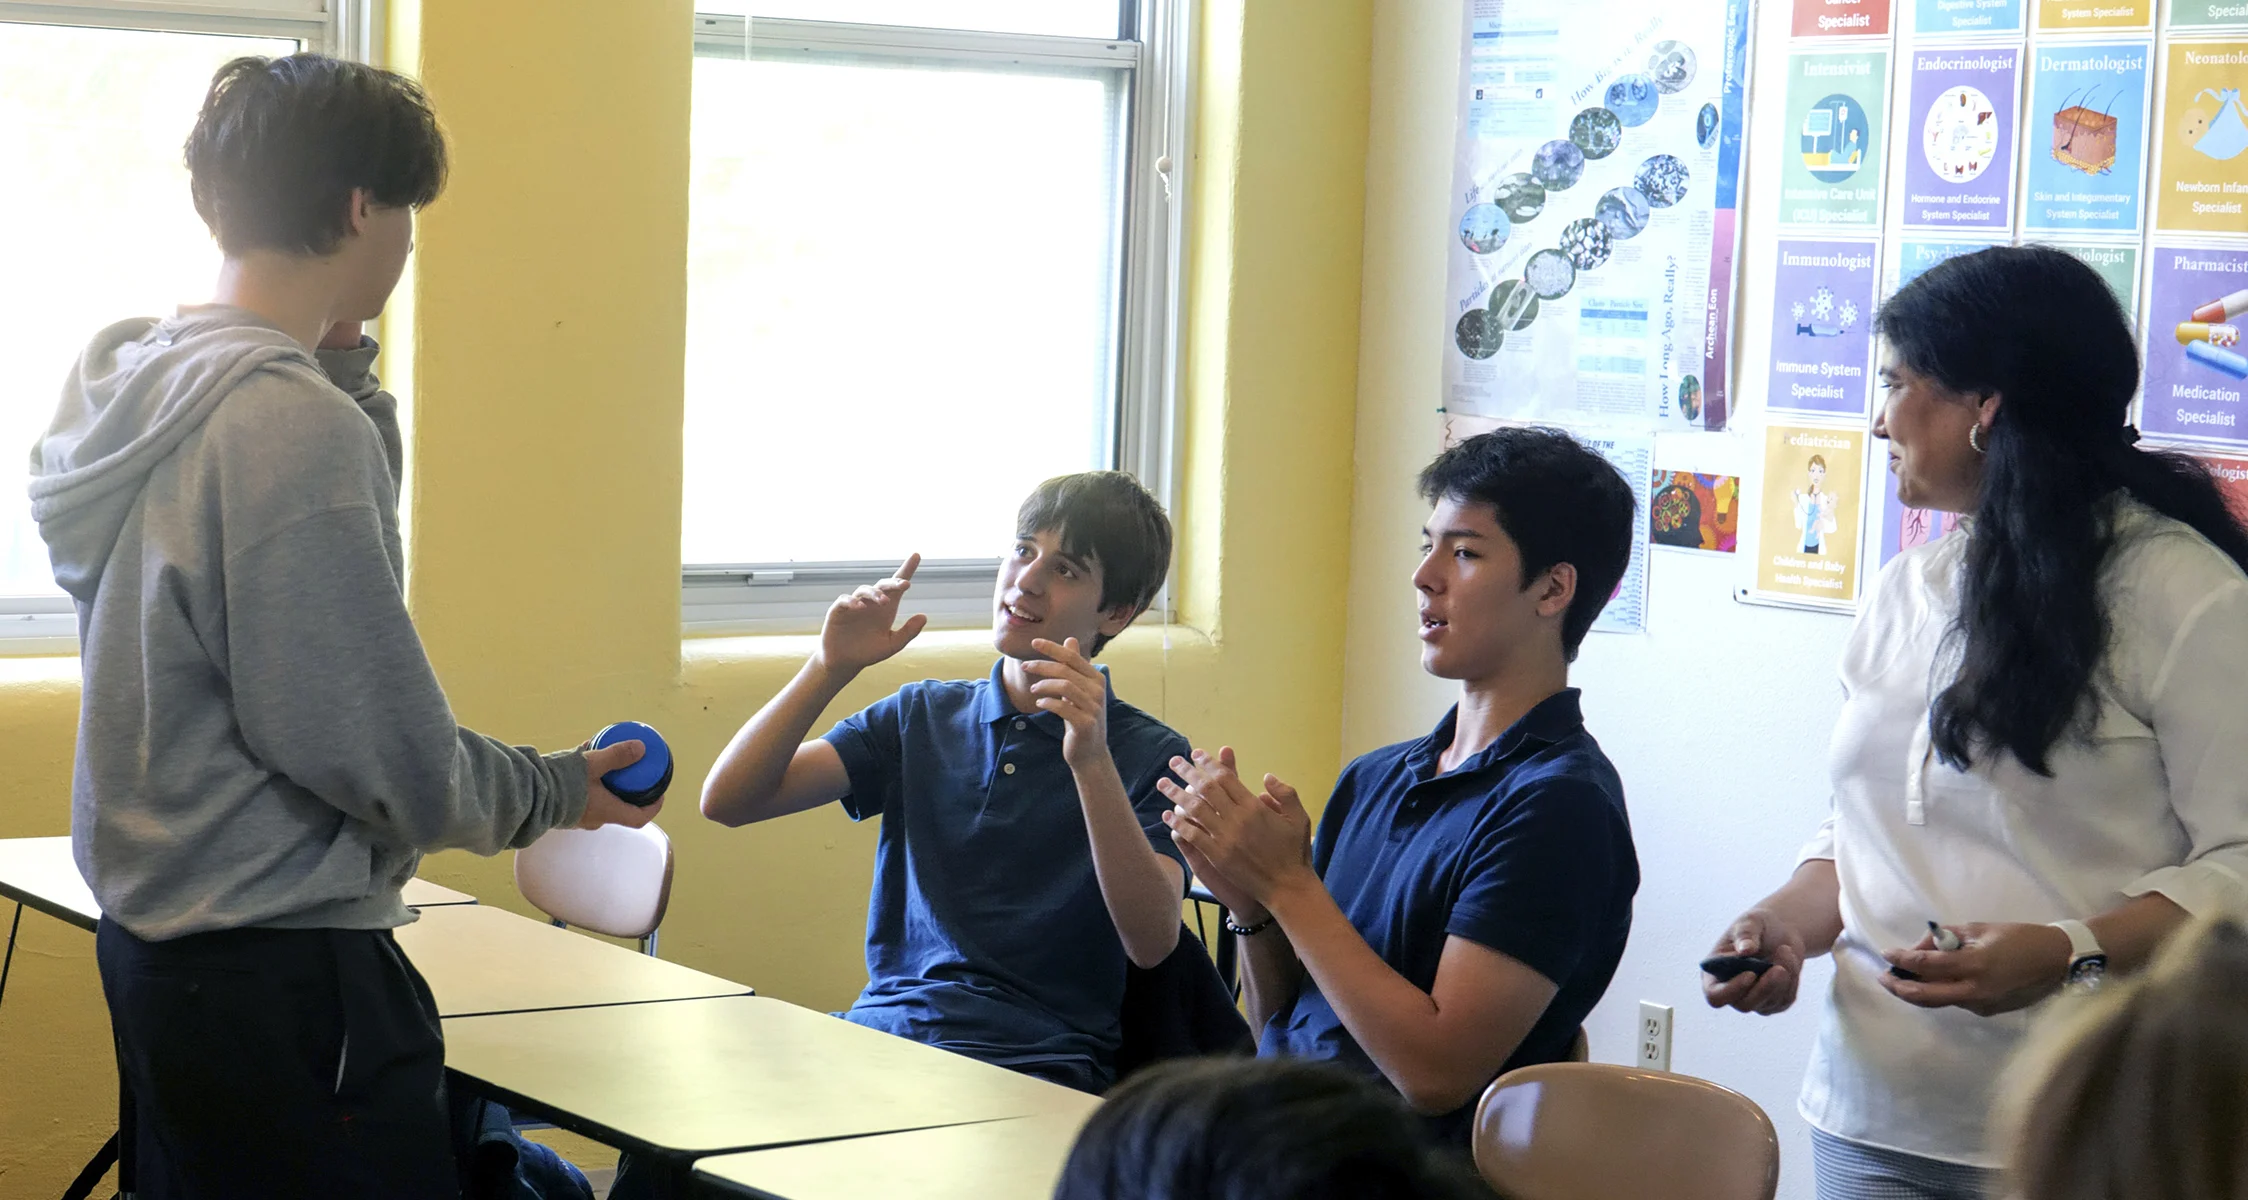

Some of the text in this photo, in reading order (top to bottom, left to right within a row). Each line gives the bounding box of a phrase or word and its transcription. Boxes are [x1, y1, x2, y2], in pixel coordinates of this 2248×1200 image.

[1937, 0, 2008, 12] Digestive System
[2062, 6, 2134, 19] System Specialist
[1727, 4, 1737, 26] Eon
[1818, 13, 1871, 30] Specialist
[1952, 15, 1992, 28] Specialist
[1804, 59, 1872, 77] Intensivist
[1917, 55, 2013, 73] Endocrinologist
[2040, 55, 2143, 75] Dermatologist
[1570, 83, 1595, 106] How
[1464, 183, 1480, 204] Life
[1830, 187, 1854, 201] Care
[1855, 188, 1876, 201] Unit
[2176, 181, 2220, 193] Newborn
[1911, 193, 2001, 205] Hormone and Endocrine
[2034, 191, 2131, 205] Skin and Integumentary
[1819, 208, 1868, 224] Specialist
[1922, 209, 1990, 222] System Specialist
[2046, 209, 2119, 221] System Specialist
[2192, 201, 2243, 215] Specialist
[1783, 251, 1871, 272] Immunologist
[2173, 255, 2248, 273] Pharmacist
[1663, 255, 1679, 304] Really?
[1705, 288, 1718, 360] Archean Eon
[1776, 360, 1862, 379] Immune System
[1791, 384, 1844, 400] Specialist
[2172, 384, 2240, 402] Medication
[1659, 384, 1669, 418] How
[2176, 408, 2236, 427] Specialist
[1807, 560, 1824, 570] and
[1824, 561, 1846, 575] Baby
[1775, 573, 1843, 590] Health Specialist
